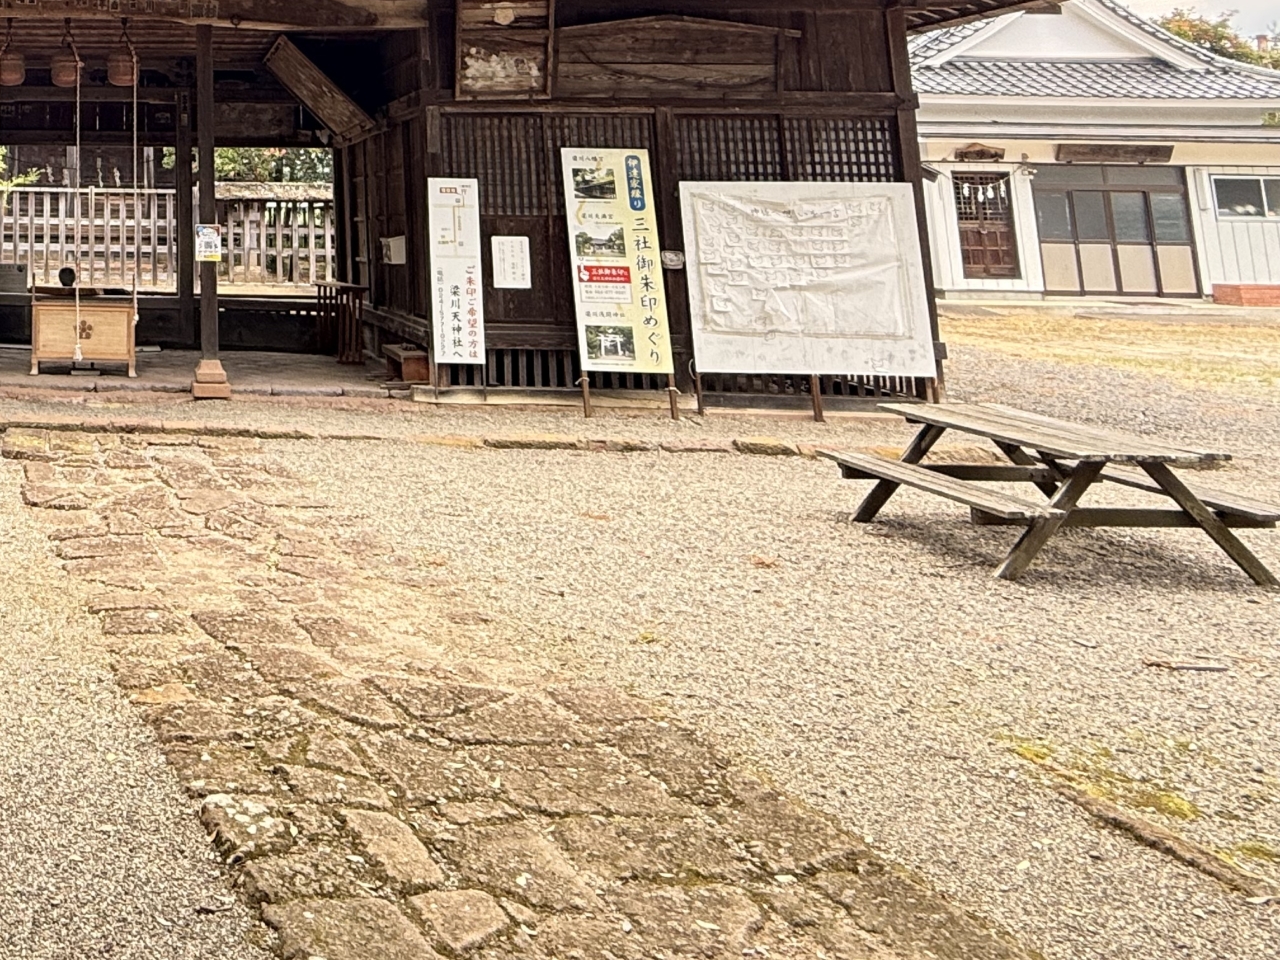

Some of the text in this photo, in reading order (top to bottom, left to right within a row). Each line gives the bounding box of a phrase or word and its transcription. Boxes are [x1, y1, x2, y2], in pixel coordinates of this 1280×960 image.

[449, 284, 464, 358] 梁川天神社へ
[465, 265, 479, 358] ご朱印ご希望の方は
[632, 217, 660, 364] 三社御朱印めぐり
